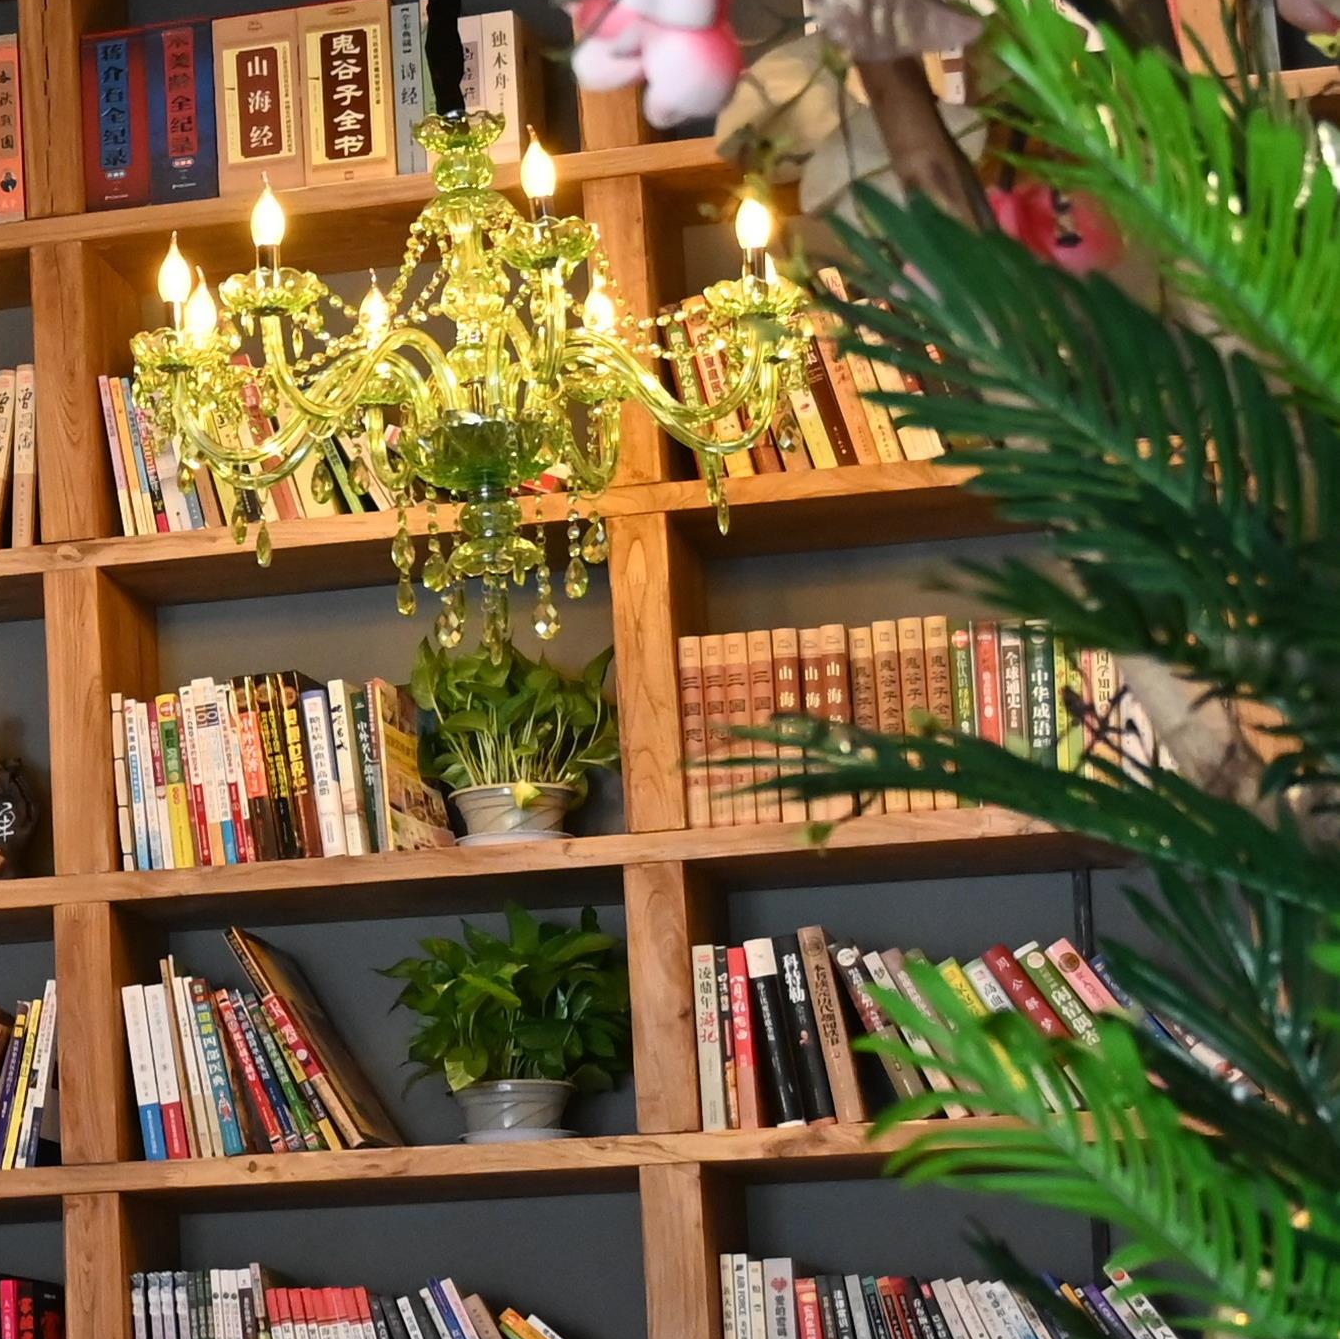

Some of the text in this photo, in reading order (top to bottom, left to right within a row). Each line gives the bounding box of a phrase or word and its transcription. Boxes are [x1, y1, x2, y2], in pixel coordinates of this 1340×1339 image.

[166, 31, 197, 156] 宋美龄全纪录
[330, 33, 366, 157] 鬼谷子全书
[399, 62, 419, 106] 诗经
[490, 29, 510, 89] 独木舟
[99, 44, 127, 169] 蒋介石全纪录
[245, 55, 274, 149] 山海经
[1005, 651, 1020, 708] 全球通史
[1031, 669, 1051, 735] 中华成语
[996, 956, 1053, 1033] 周公解梦
